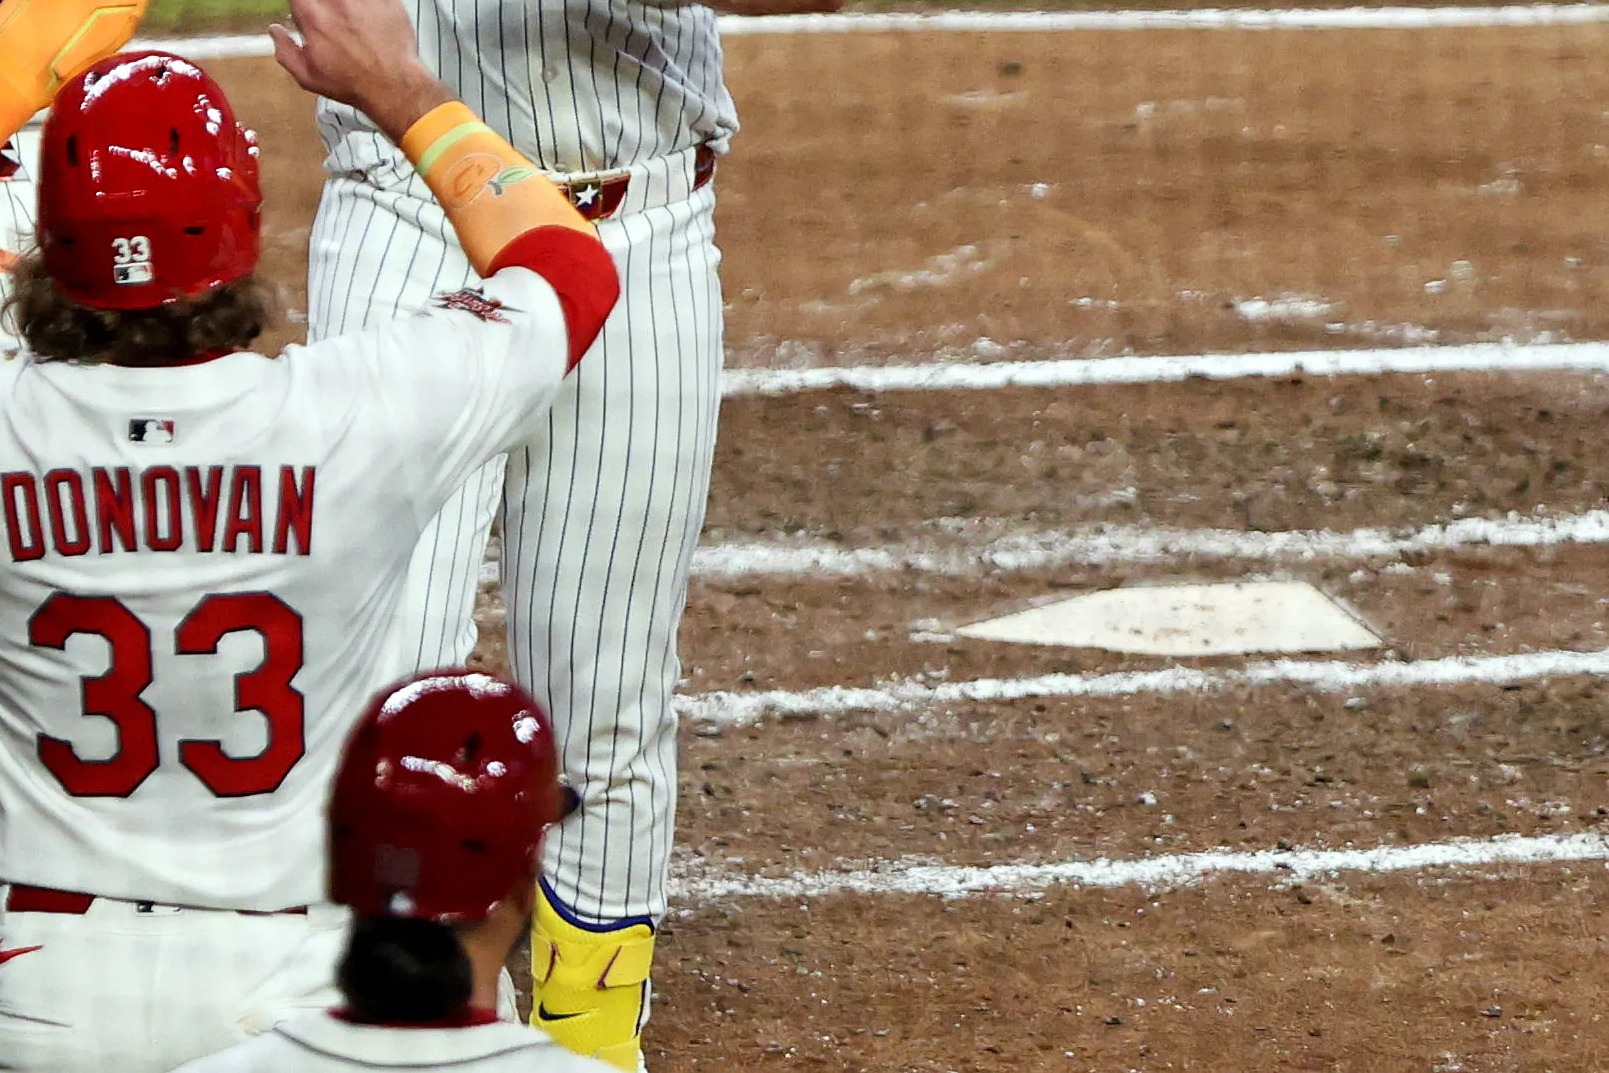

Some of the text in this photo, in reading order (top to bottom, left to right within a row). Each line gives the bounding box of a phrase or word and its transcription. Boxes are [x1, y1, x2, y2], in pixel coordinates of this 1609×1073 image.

[111, 236, 151, 264] 33
[0, 465, 317, 562] DONOVAN
[28, 591, 306, 798] 33
